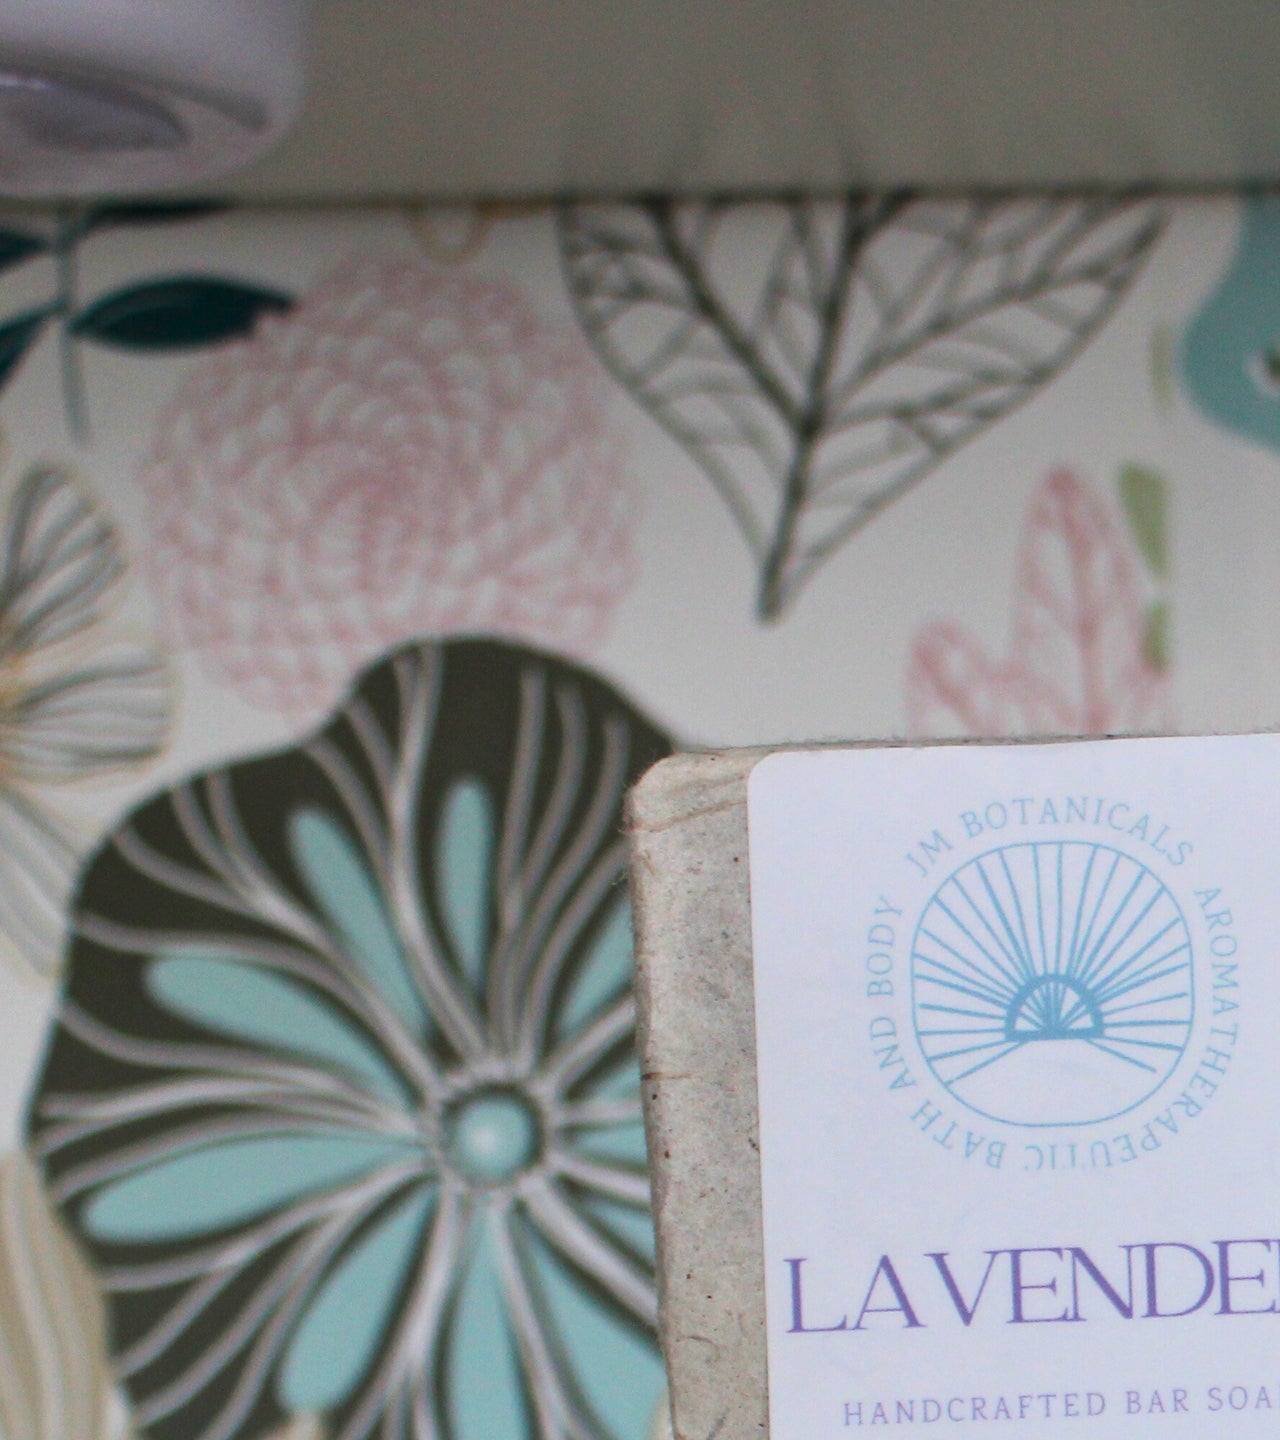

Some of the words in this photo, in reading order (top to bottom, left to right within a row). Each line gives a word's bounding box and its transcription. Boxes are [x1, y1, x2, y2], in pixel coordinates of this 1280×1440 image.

[904, 829, 954, 878] JM
[960, 796, 1196, 869] BOTANICALS
[866, 894, 904, 999] BODY
[870, 1015, 918, 1093] AND
[1024, 886, 1240, 1171] AROMATHERAPEUTIC
[909, 1100, 1007, 1170] BATH
[843, 1392, 1107, 1427] HANDCRAFTED
[1125, 1388, 1190, 1415] BAR
